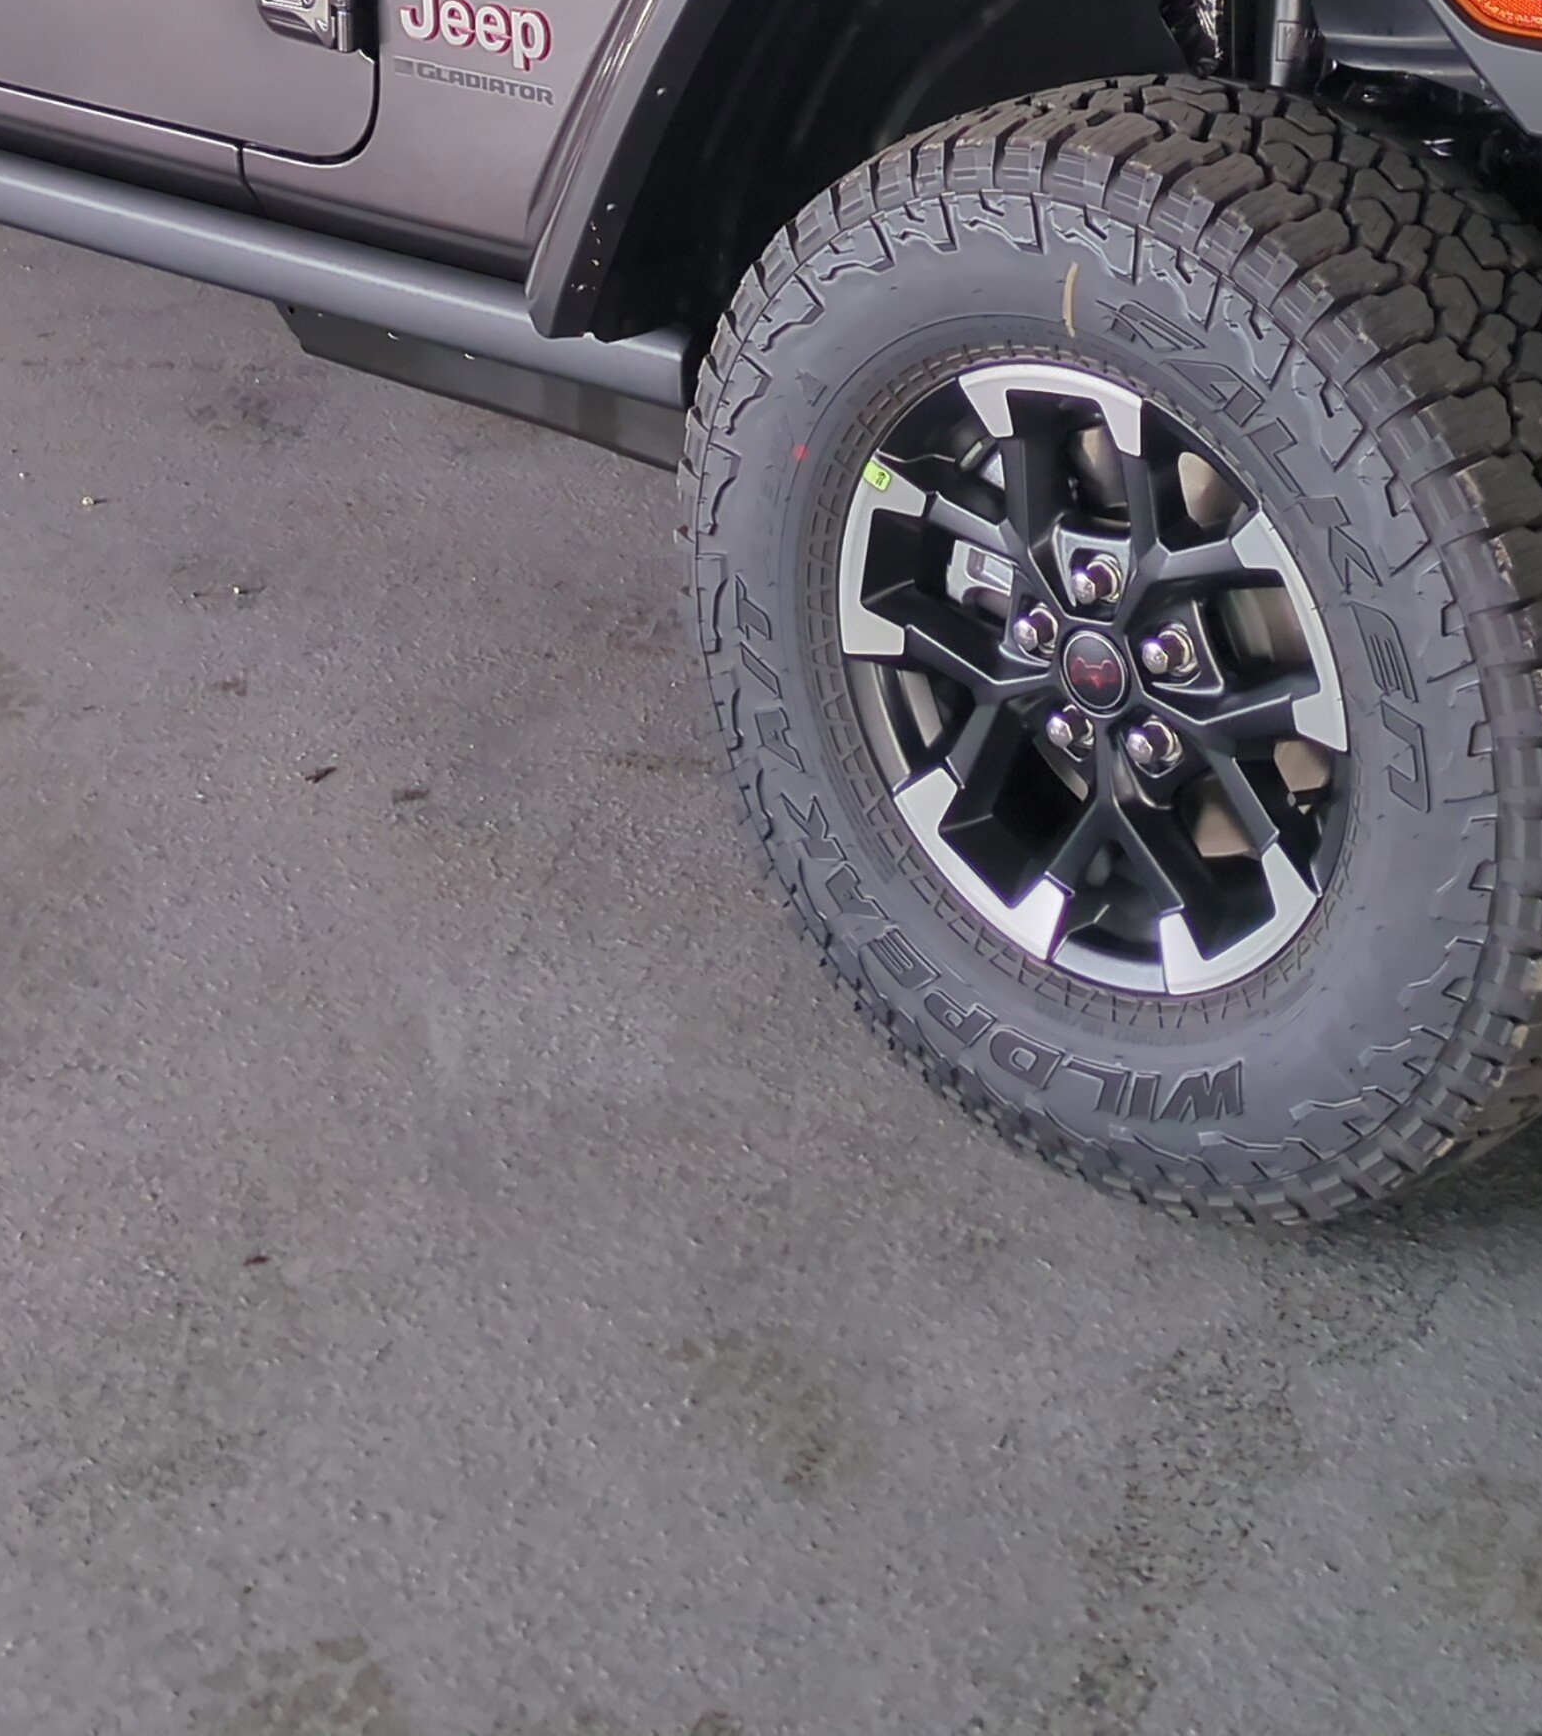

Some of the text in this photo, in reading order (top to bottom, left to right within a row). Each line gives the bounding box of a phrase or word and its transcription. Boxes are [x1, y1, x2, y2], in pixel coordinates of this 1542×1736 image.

[416, 63, 555, 106] GLADIATOR
[735, 573, 806, 774] A/T
[1095, 298, 1432, 814] FALKEN
[780, 792, 1244, 1124] WILDPEAK
